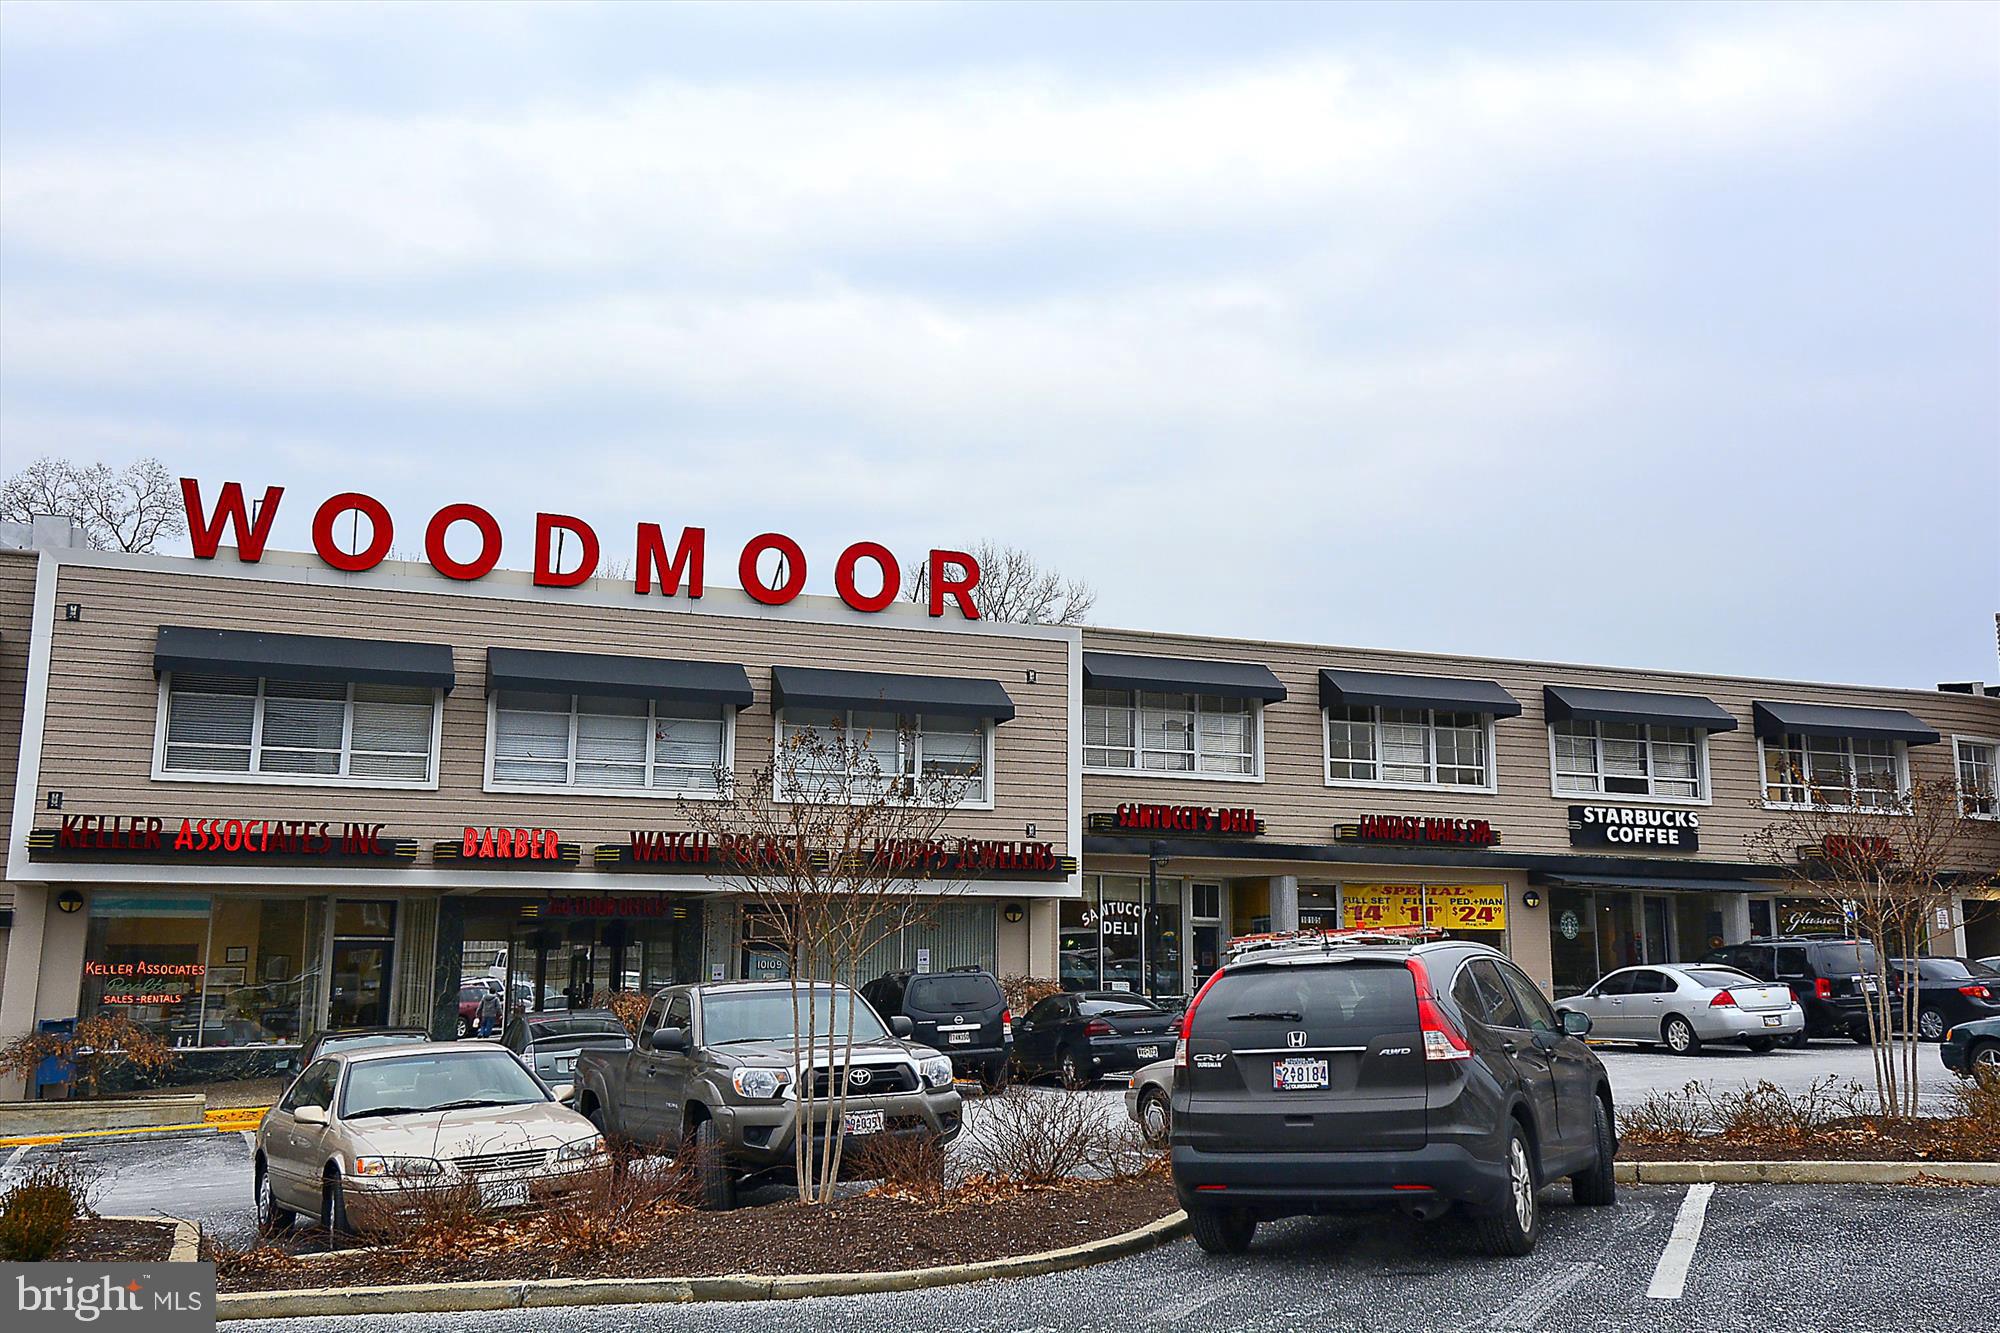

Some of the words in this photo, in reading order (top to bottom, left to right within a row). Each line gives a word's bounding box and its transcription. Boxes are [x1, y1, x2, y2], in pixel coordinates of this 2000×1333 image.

[180, 478, 981, 620] WOODMOOR
[1117, 803, 1214, 830] SANTUCCI'S
[1219, 808, 1255, 833] DELI
[1360, 814, 1421, 840] FANTASY
[1424, 817, 1464, 842] NAILS
[1466, 819, 1491, 843] SPA
[1584, 807, 1699, 827] STARBUCKS
[60, 815, 162, 849] KELLER
[174, 818, 330, 854] ASSOCIATES
[343, 823, 387, 856] INC
[463, 826, 559, 859] BARBER
[630, 831, 709, 862] WATCH
[1607, 826, 1679, 844] COFFEE
[1104, 921, 1138, 935] DELI
[757, 960, 782, 969] 10109
[104, 995, 134, 1004] SALES
[1379, 1047, 1411, 1056] AWD
